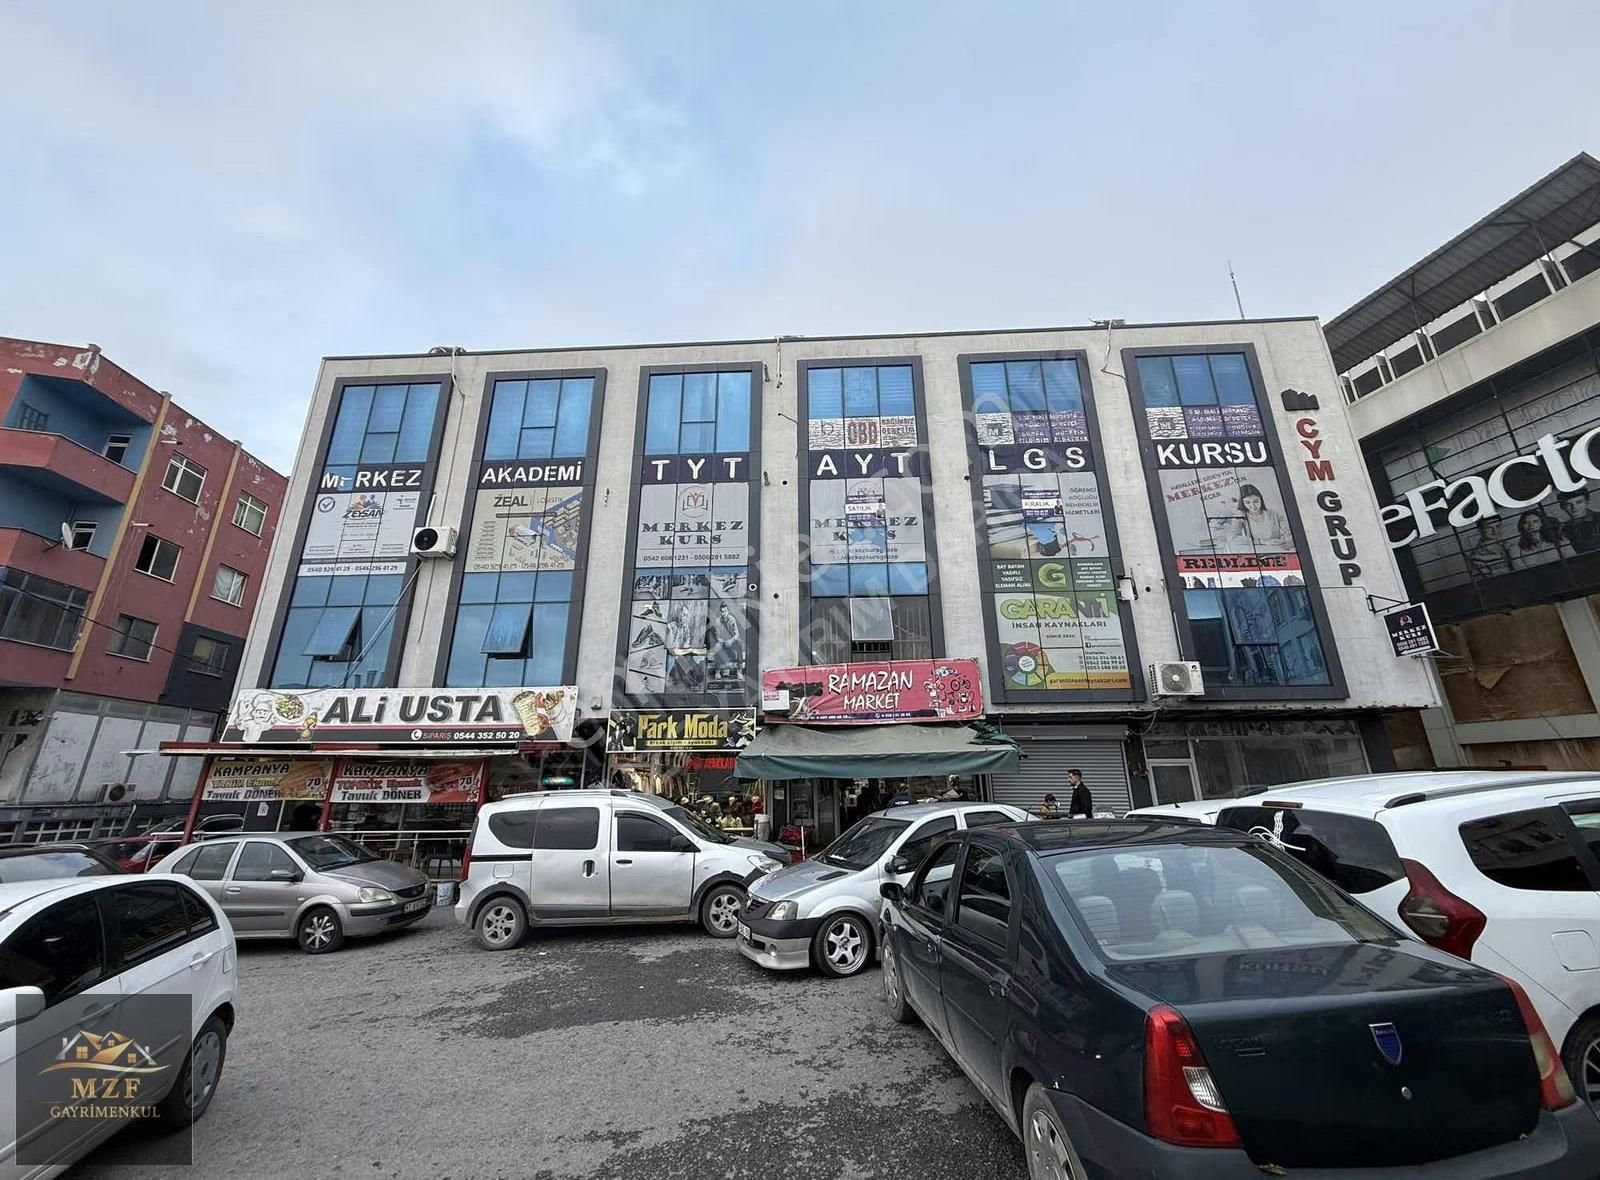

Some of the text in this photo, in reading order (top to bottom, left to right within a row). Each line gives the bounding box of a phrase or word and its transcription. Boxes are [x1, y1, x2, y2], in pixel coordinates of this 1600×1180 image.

[1157, 441, 1267, 465] KURSU
[482, 461, 582, 483] AKADEMİ
[493, 496, 528, 507] ZEAL
[1296, 418, 1361, 586] CYM GRUP
[642, 521, 743, 532] MERKEZ
[660, 534, 721, 545] KURS
[828, 670, 913, 693] RAMAZAN
[399, 694, 503, 722] USTA
[843, 693, 901, 711] MARKET
[637, 714, 729, 739] Park Moda
[453, 731, 476, 740] 0544
[477, 731, 494, 739] 352
[495, 731, 508, 739] 50
[508, 731, 520, 739] 20
[213, 763, 290, 777] KAMPANYA
[343, 764, 429, 777] KAMPANYA
[306, 777, 321, 787] 70
[459, 776, 473, 786] 70
[243, 787, 281, 800] DÖNER
[341, 787, 422, 801] Tavuk DÖNER
